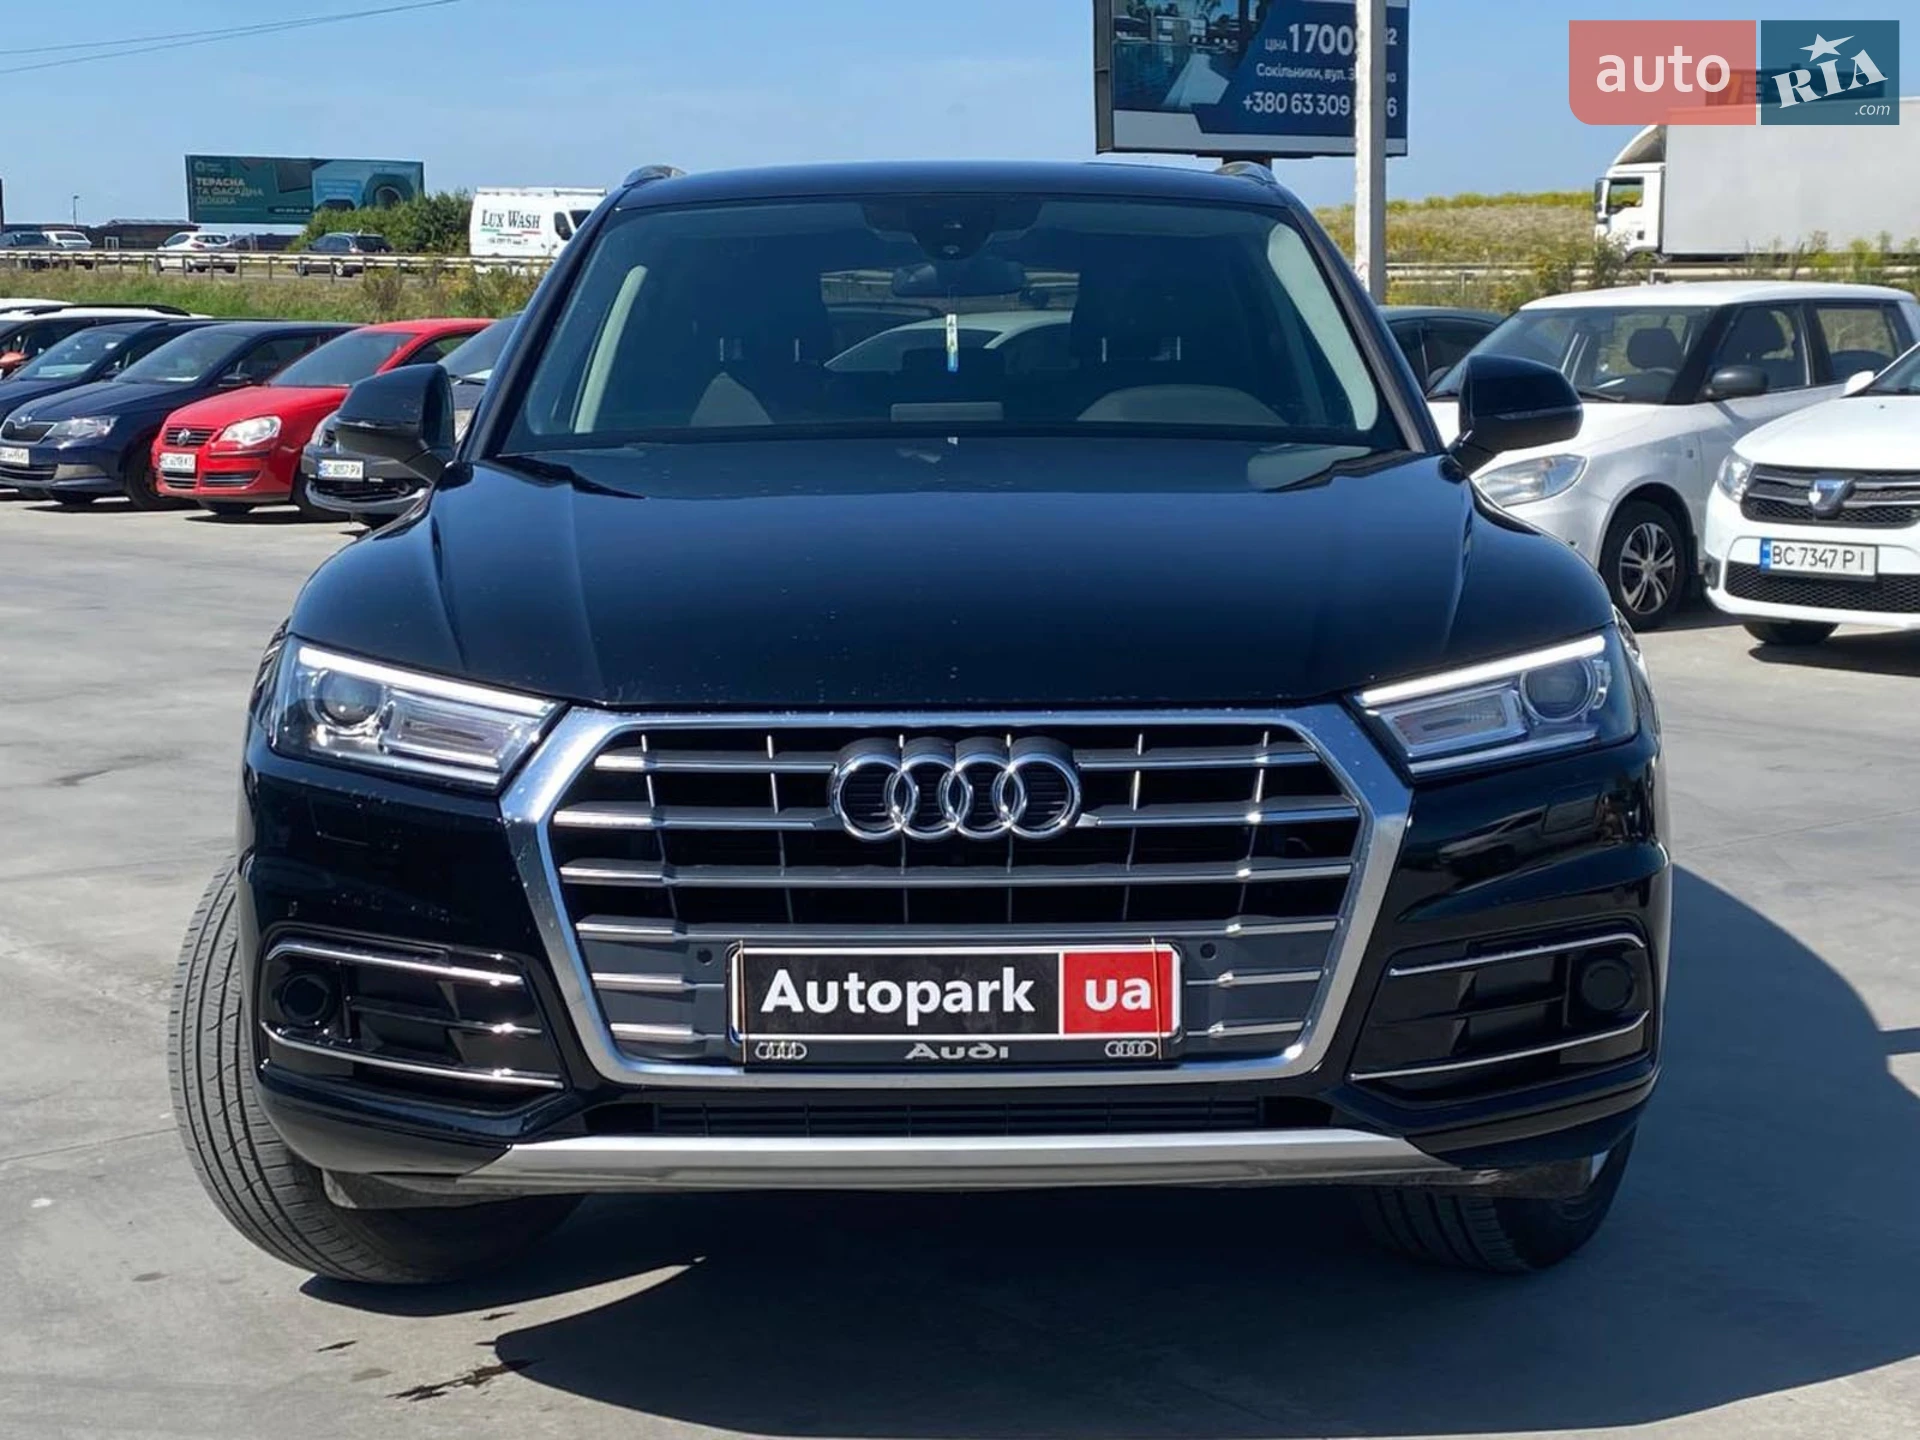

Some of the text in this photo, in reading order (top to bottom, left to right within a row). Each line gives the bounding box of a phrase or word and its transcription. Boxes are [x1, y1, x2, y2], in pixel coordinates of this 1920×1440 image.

[1289, 24, 1354, 56] 1700
[1243, 92, 1287, 113] +380
[1291, 92, 1314, 114] 63
[1316, 94, 1350, 115] 309
[1772, 545, 1796, 566] BC
[1798, 547, 1838, 569] 7347
[760, 966, 1152, 1026] Autopark ua
